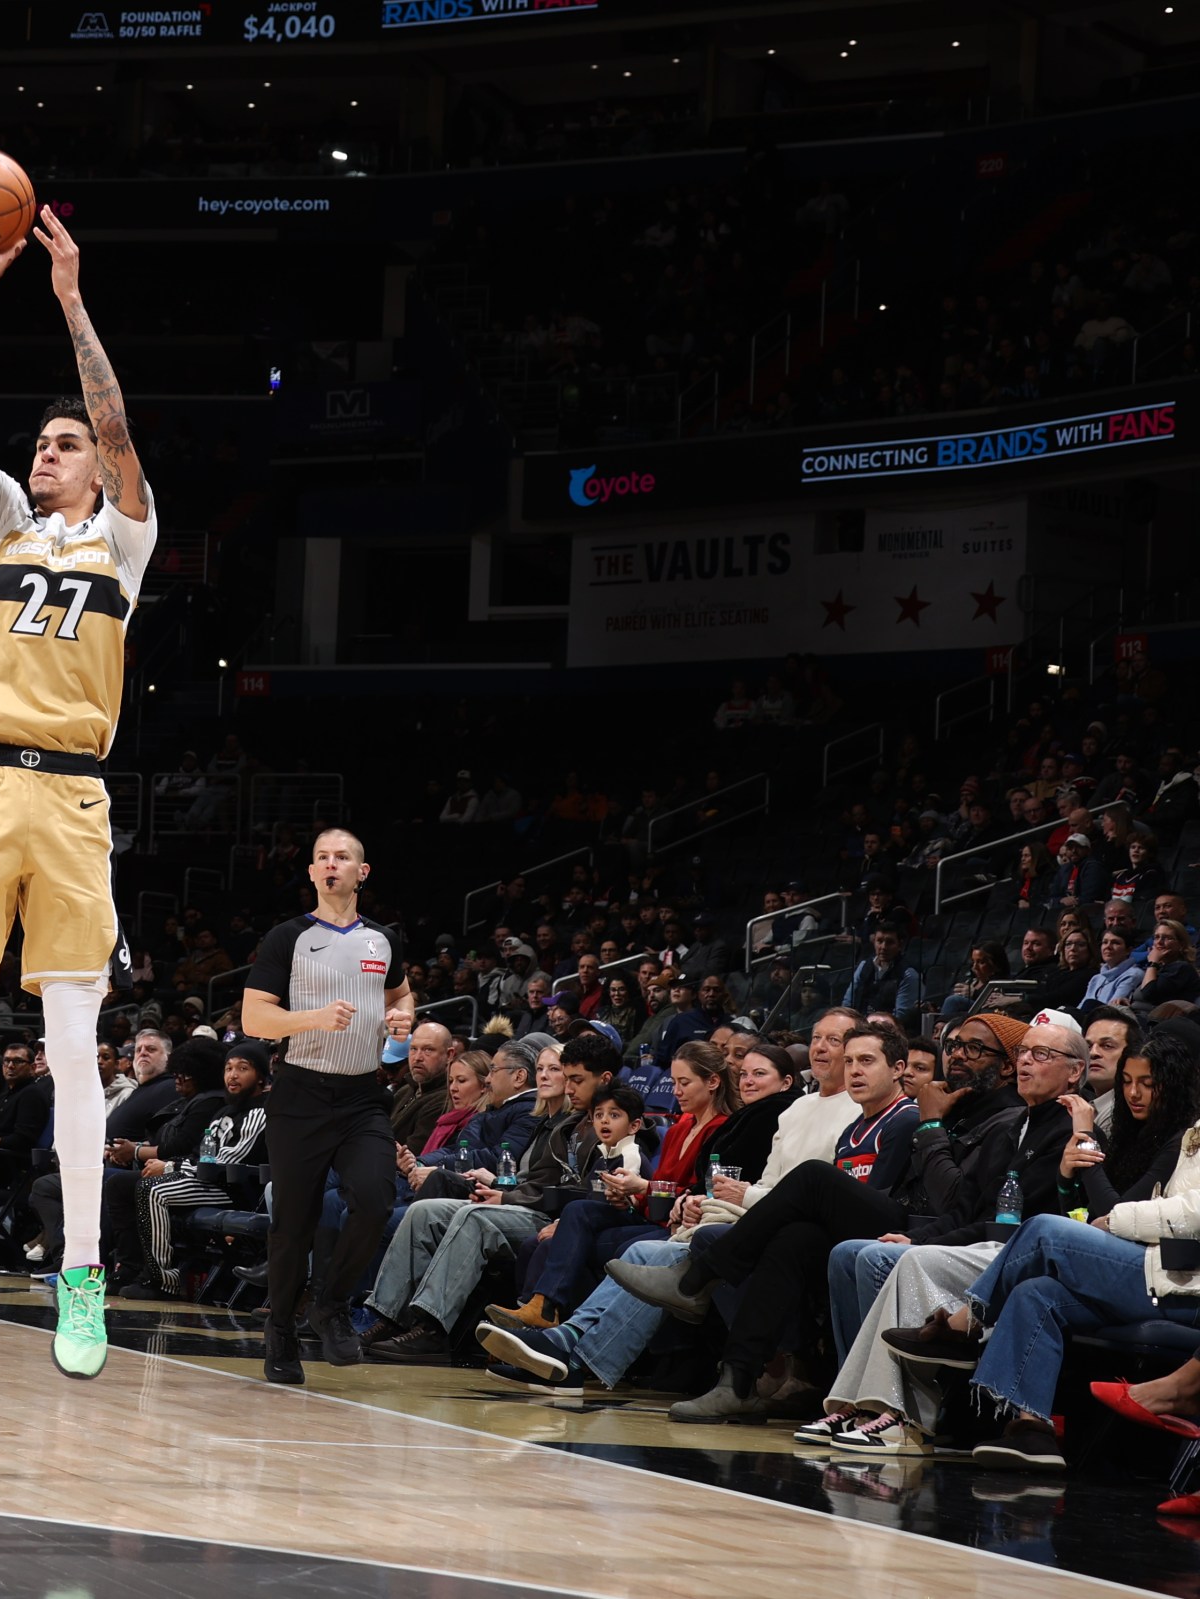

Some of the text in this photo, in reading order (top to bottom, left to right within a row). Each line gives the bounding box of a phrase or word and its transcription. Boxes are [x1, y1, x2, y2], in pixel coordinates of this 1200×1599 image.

[267, 2, 317, 12] JACKPOT
[121, 11, 201, 23] FOUNDATION
[119, 25, 202, 38] 50/50 RAFFLE
[244, 15, 335, 42] $4,040
[198, 197, 329, 215] hey-coyote.com
[801, 406, 1176, 474] CONNECTING BRANDS WITH FANS
[878, 528, 944, 552] MONUMENTAL
[962, 538, 1013, 554] SUITES
[594, 532, 791, 582] THE VAULTS
[8, 572, 93, 642] 27
[606, 607, 769, 632] PAIRED WITH ELITE SEATING
[1119, 640, 1142, 657] 113
[242, 677, 264, 691] 114
